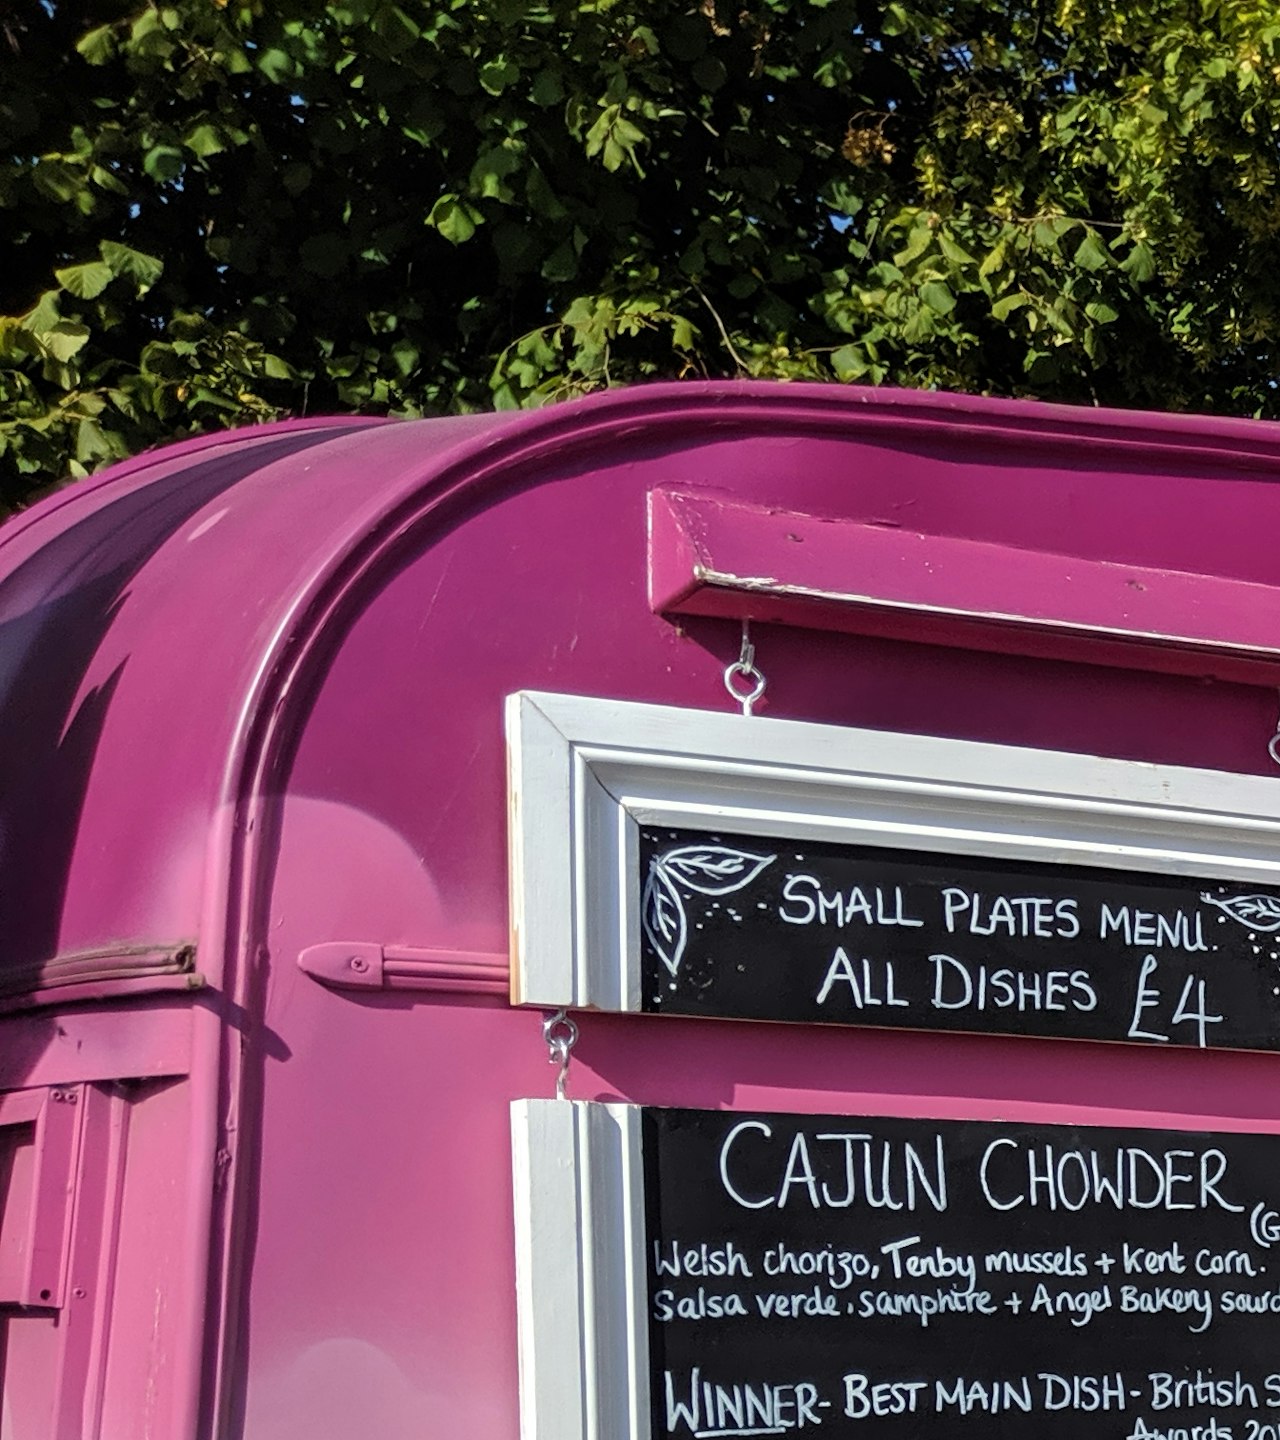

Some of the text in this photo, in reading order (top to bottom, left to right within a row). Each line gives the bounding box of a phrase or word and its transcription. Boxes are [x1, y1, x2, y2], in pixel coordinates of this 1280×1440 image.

[779, 875, 924, 927] SMALL
[942, 887, 1079, 939] PLATES
[816, 947, 1223, 1048] ALL DISHES £4
[720, 1120, 949, 1211] CAJUN
[980, 1139, 1244, 1213] CHOWDER
[653, 1242, 753, 1279] Welsh
[763, 1244, 879, 1290] chorizo,
[881, 1236, 976, 1290] Tenby
[984, 1245, 1087, 1276] mussels
[1094, 1253, 1113, 1276] +
[653, 1288, 744, 1323] Salsa
[860, 1288, 997, 1327] samphire
[1004, 1294, 1023, 1314] +
[1029, 1288, 1111, 1327] Angel
[1120, 1288, 1211, 1331] Bakery
[843, 1375, 929, 1418] BEST
[935, 1377, 1031, 1415] MAIN
[1148, 1366, 1257, 1409] British
